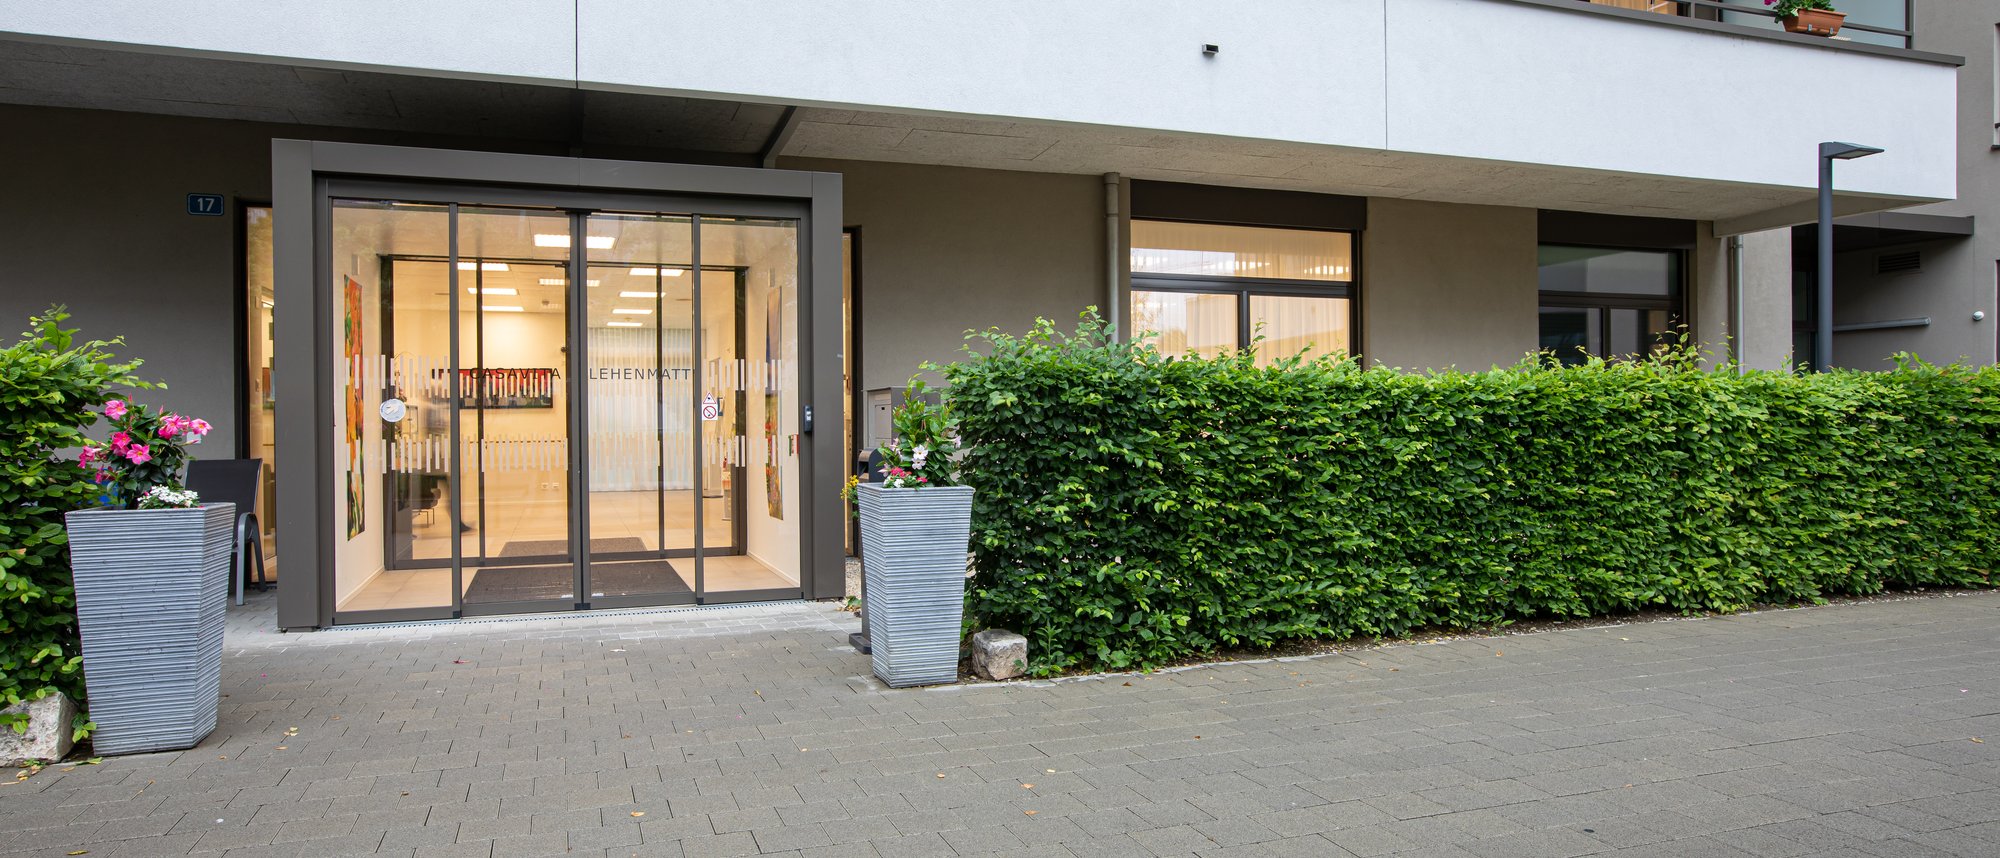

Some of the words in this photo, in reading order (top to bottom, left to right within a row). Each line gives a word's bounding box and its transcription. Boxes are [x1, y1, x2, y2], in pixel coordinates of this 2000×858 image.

[197, 197, 215, 211] 17
[469, 367, 561, 380] CASAVITA
[589, 367, 691, 380] LEHENMATT
